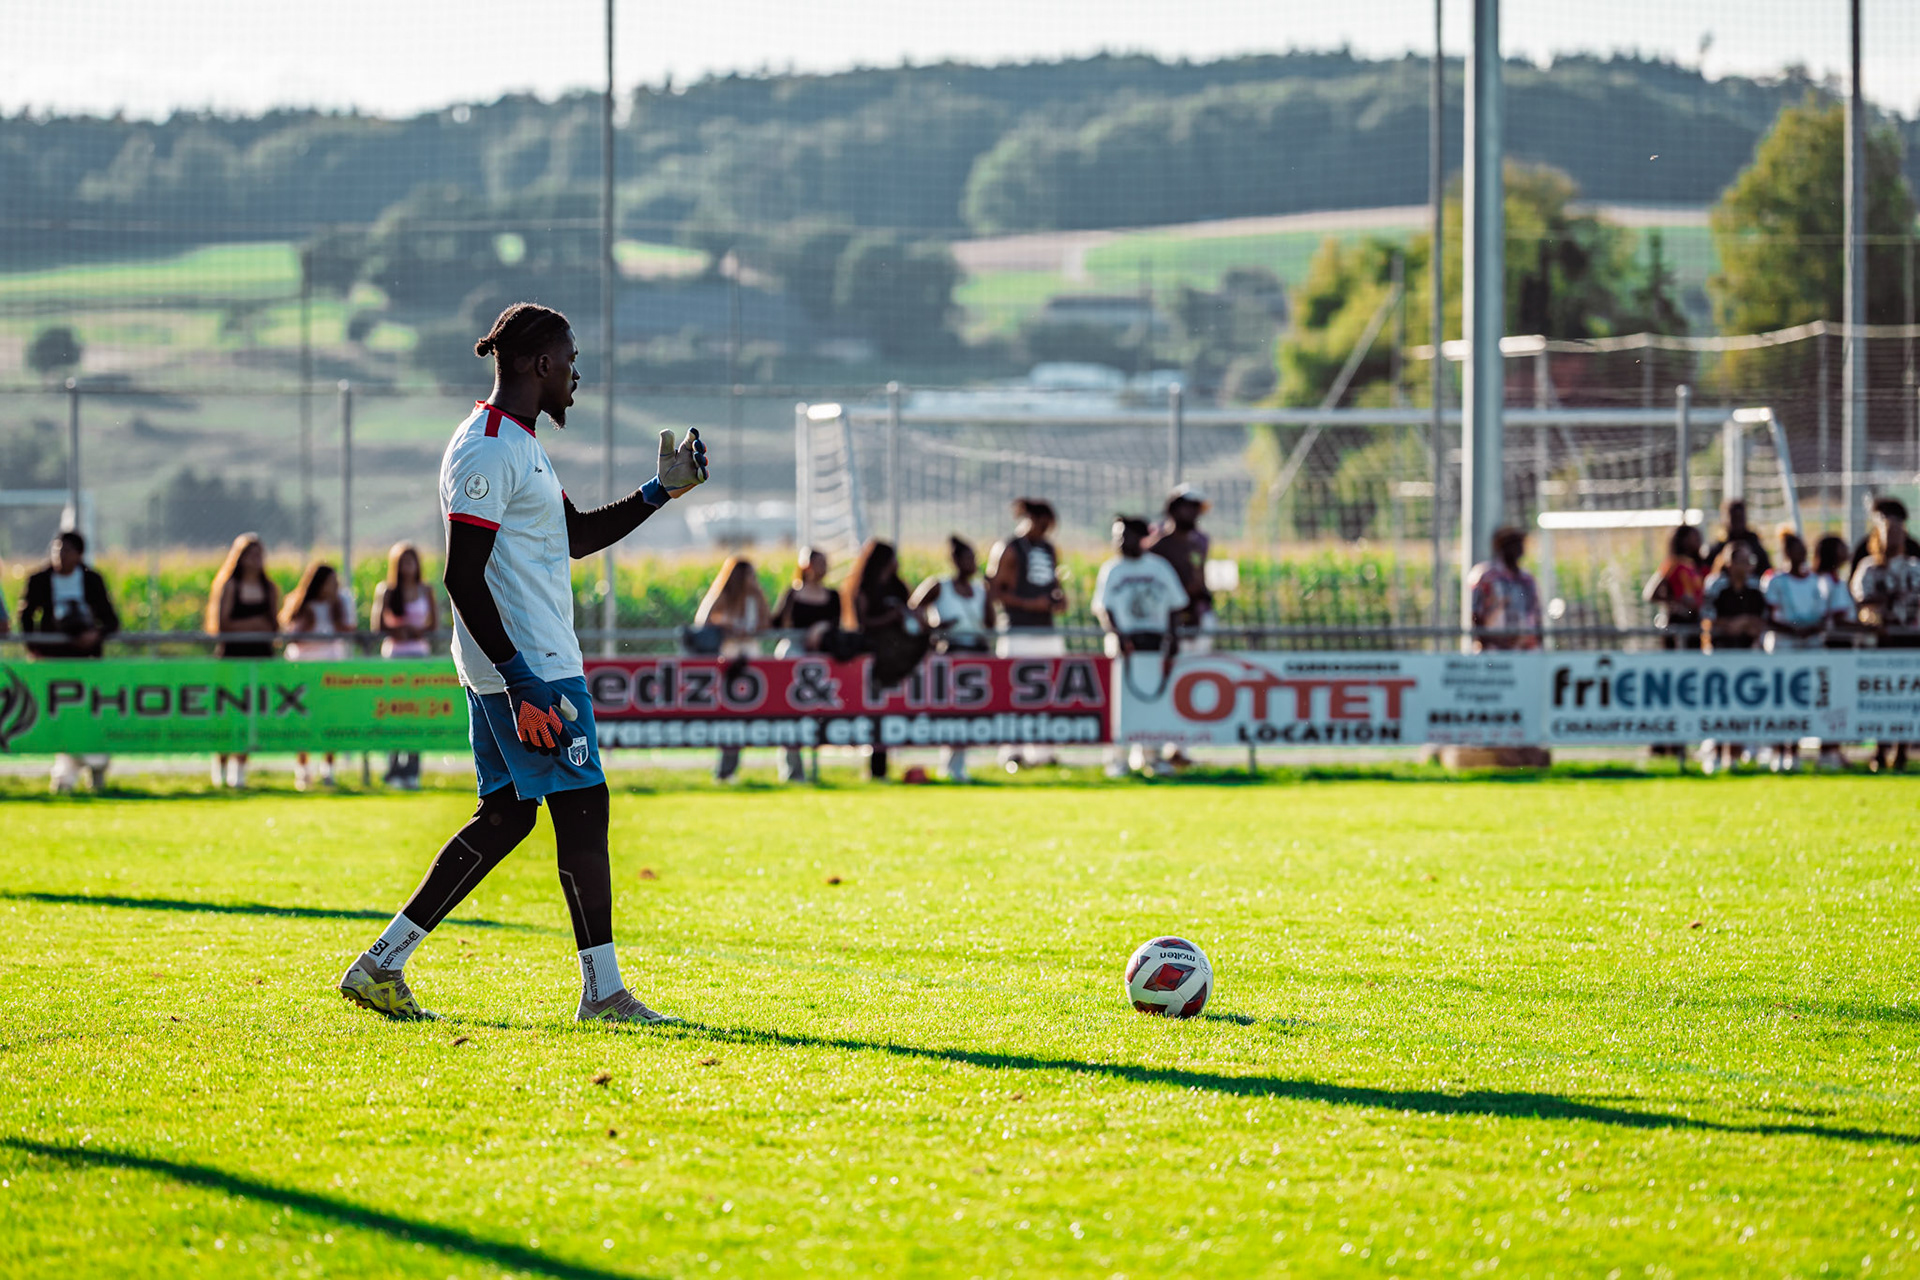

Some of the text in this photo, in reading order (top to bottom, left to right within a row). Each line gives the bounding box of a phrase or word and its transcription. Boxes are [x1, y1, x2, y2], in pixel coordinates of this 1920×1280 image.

[48, 680, 307, 717] PHOENIX
[786, 659, 844, 710] &
[1010, 658, 1104, 708] SA
[1173, 671, 1416, 722] OTTET
[826, 716, 874, 745] et
[880, 713, 1099, 745] Démolition
[1238, 724, 1401, 742] LOCATION
[1553, 716, 1810, 734] CHAUFFAGE SANITAIRE
[1159, 951, 1196, 962] molten
